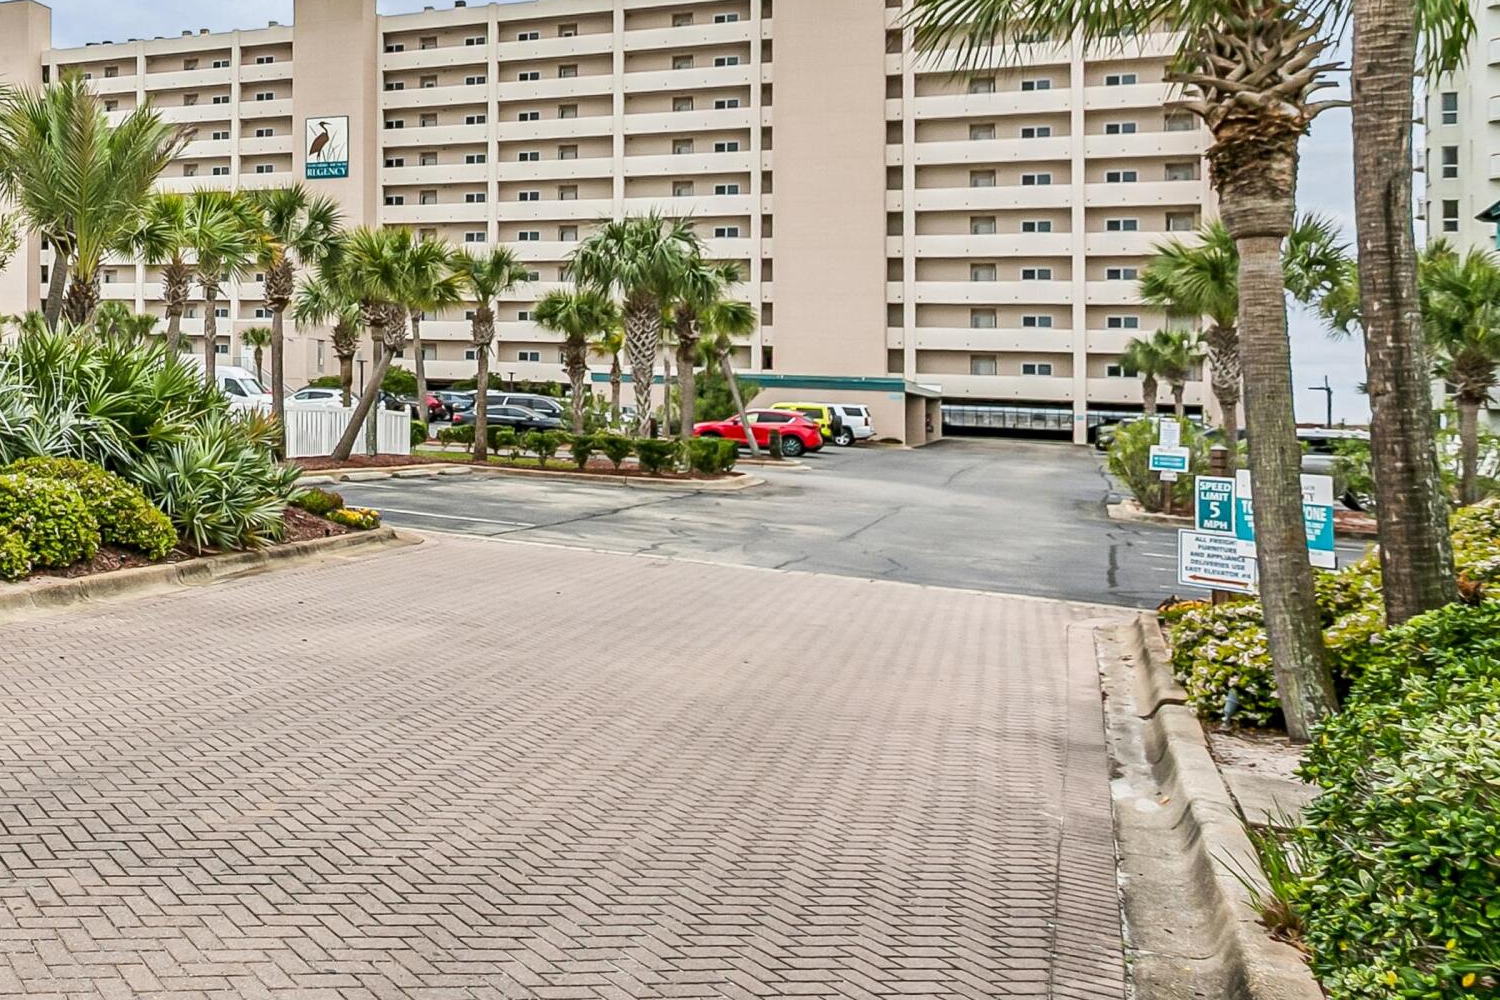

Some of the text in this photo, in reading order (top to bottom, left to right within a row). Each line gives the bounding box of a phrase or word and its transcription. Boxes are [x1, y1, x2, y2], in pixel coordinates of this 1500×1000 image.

[307, 167, 347, 176] REGENCY
[1199, 481, 1231, 492] SPEED
[1200, 491, 1230, 502] LIMIT
[1209, 501, 1220, 518] 5
[1303, 505, 1327, 521] ONE
[1203, 519, 1228, 530] MPH
